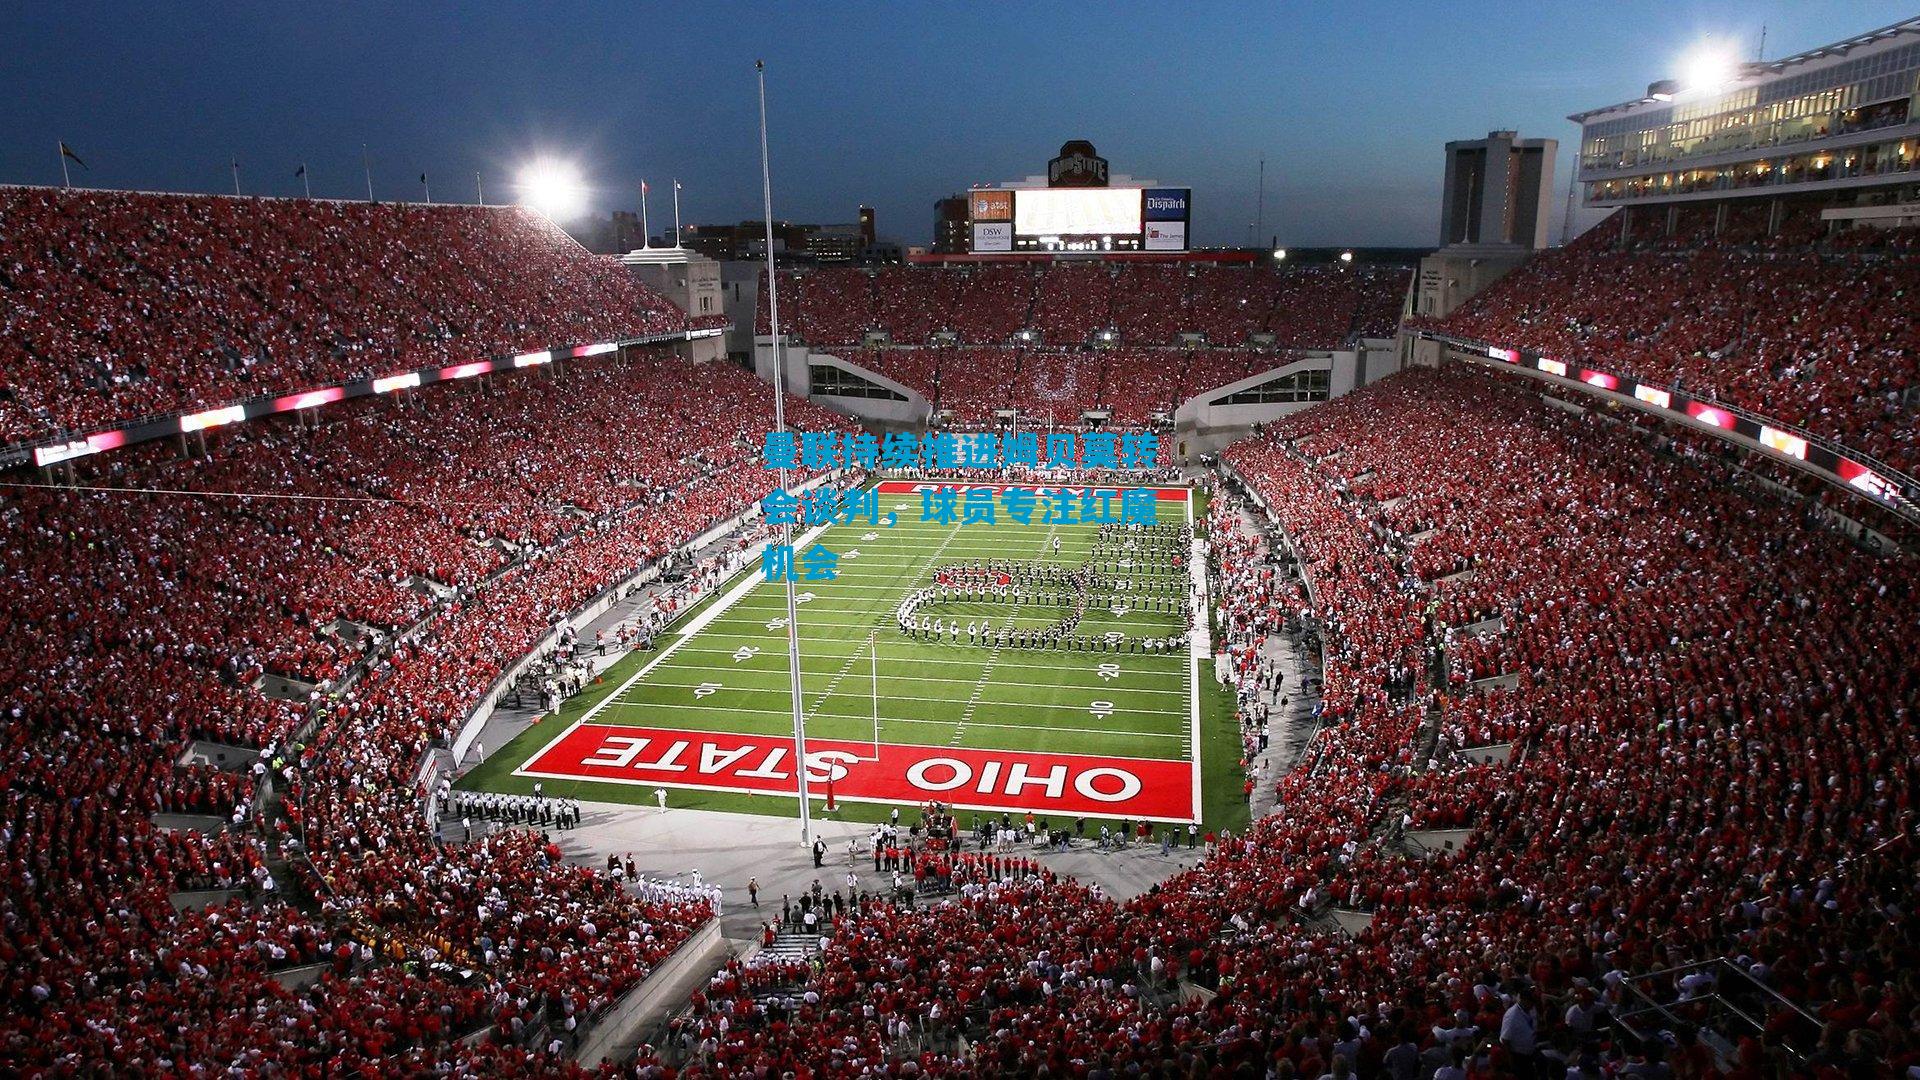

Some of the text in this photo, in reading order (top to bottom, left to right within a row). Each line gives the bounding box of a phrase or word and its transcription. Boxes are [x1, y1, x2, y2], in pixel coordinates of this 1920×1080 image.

[1147, 197, 1185, 211] Dispatch
[983, 228, 1002, 236] DSW
[1097, 663, 1120, 678] 20
[693, 682, 723, 696] 10
[1088, 701, 1114, 715] 10
[580, 735, 1142, 802] STATE OHIO
